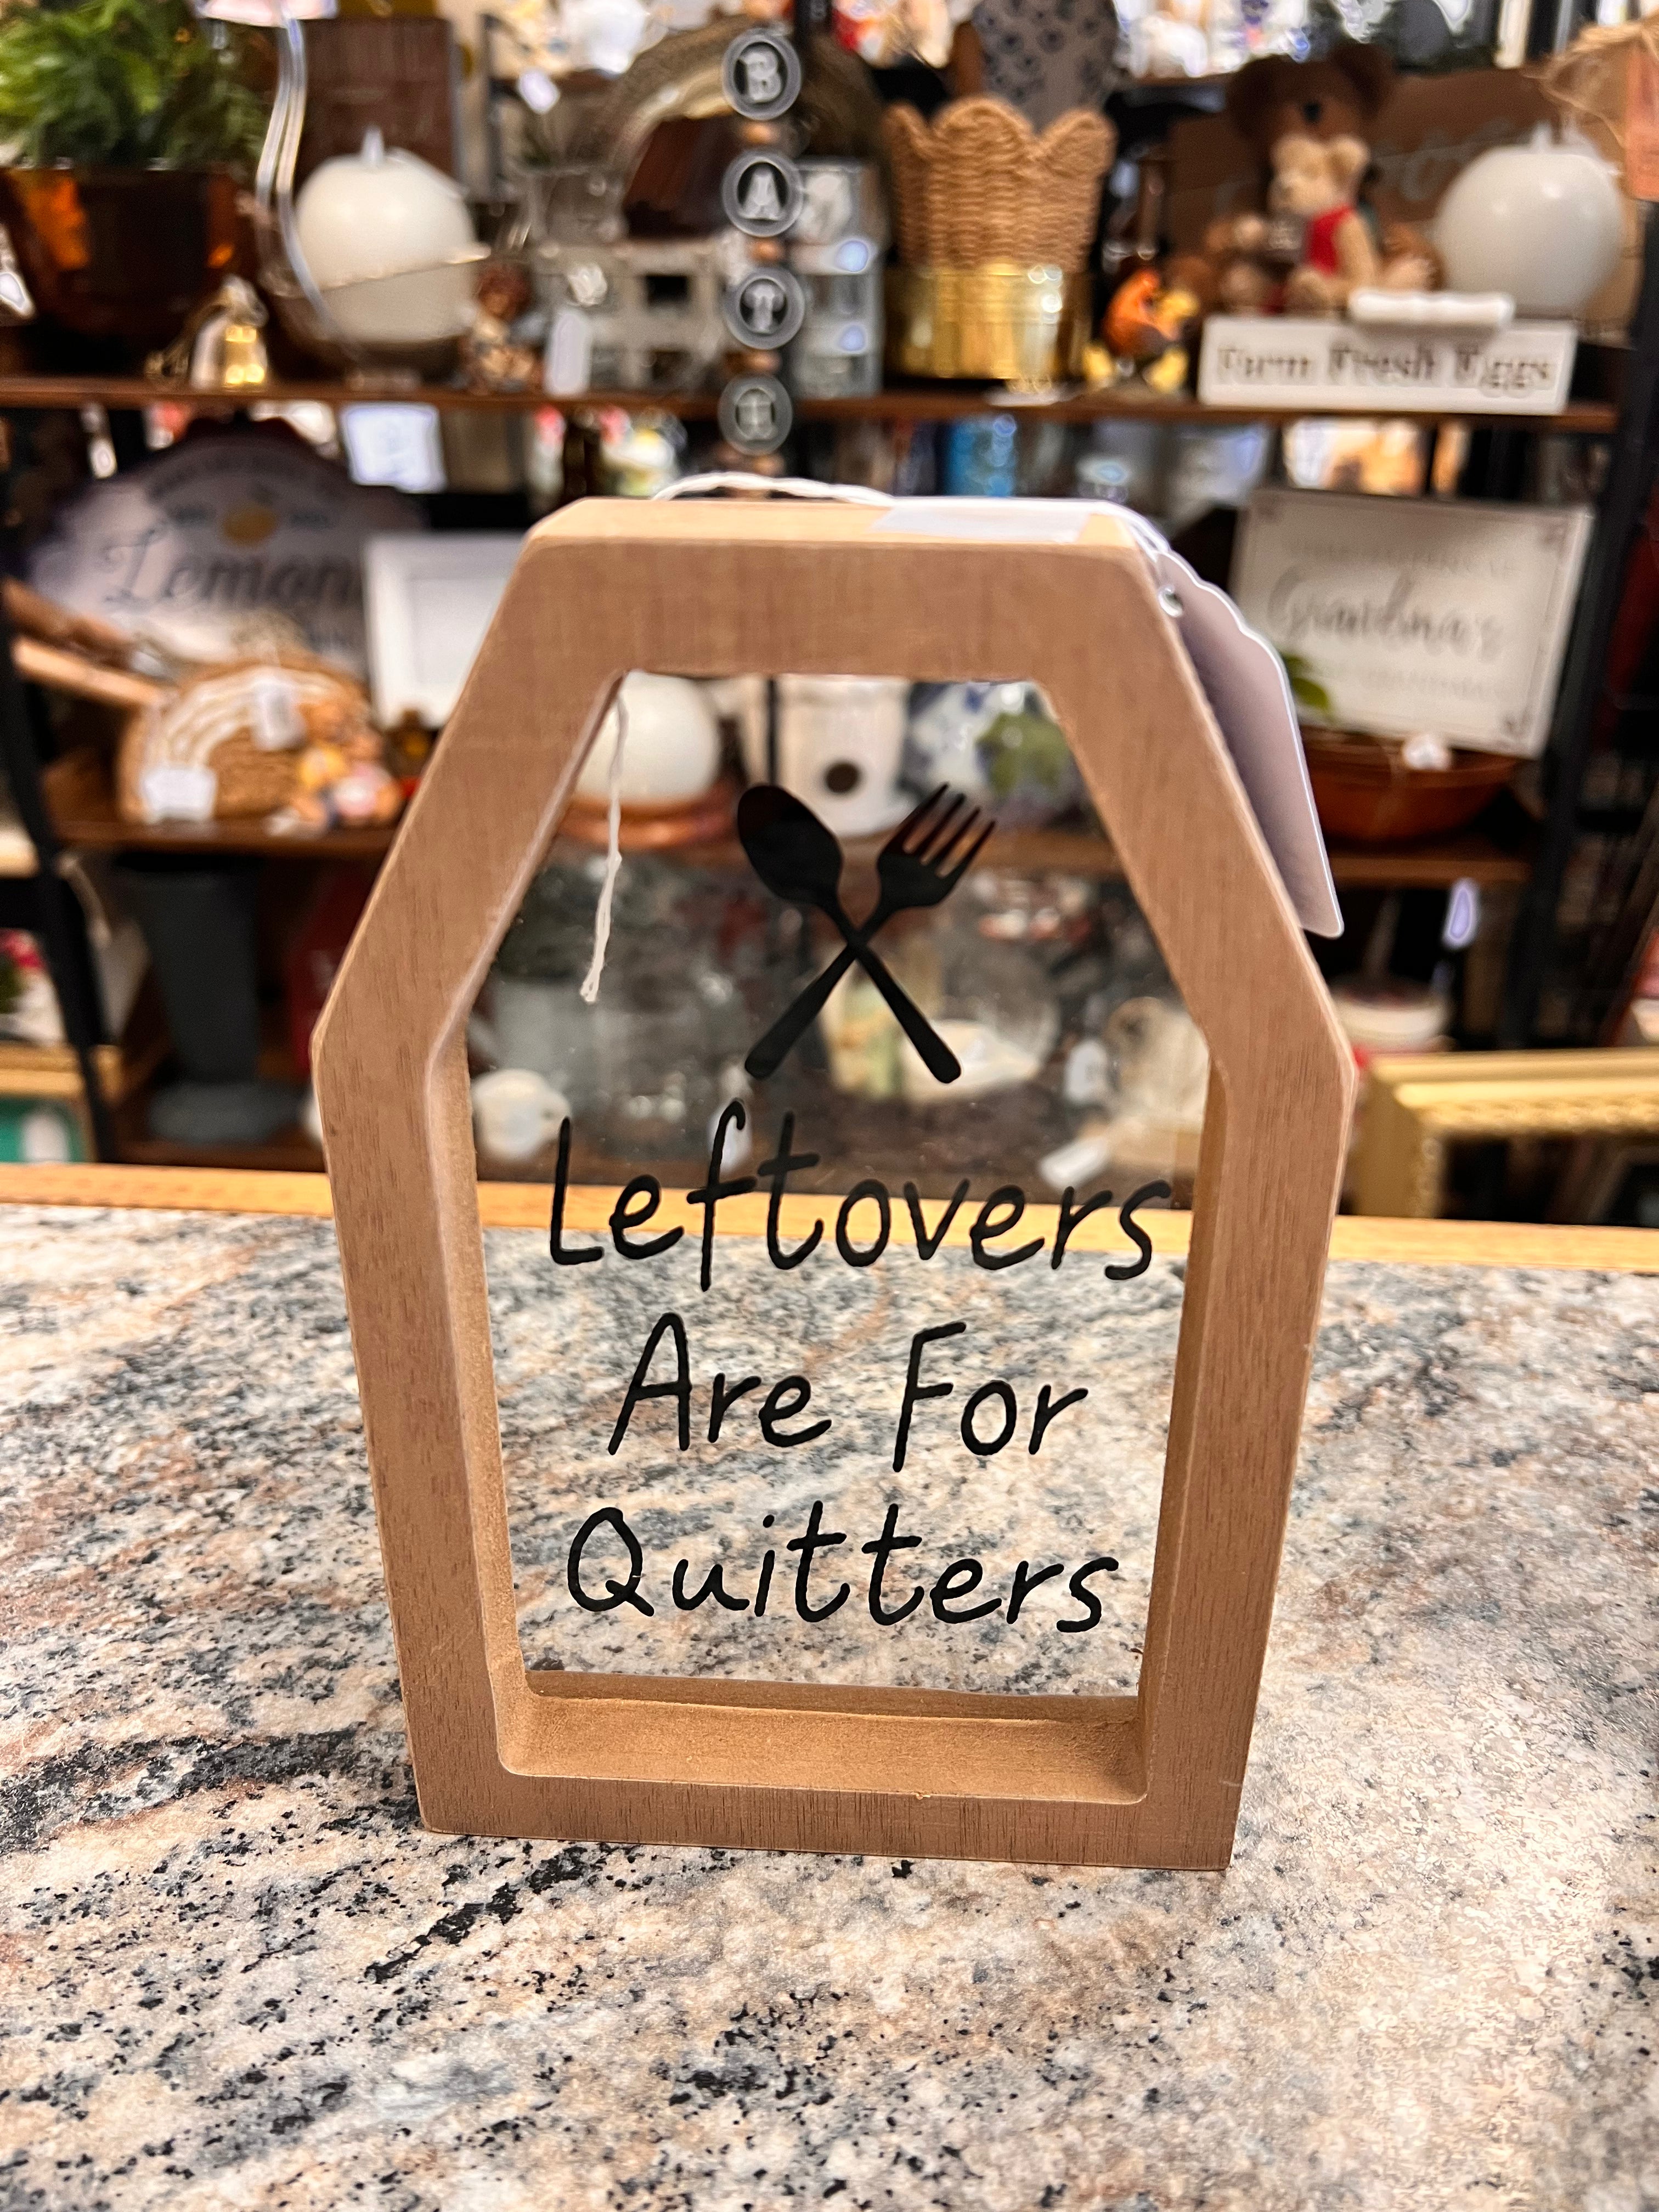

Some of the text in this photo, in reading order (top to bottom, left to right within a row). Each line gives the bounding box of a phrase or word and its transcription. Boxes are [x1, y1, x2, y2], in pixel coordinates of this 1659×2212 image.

[1216, 343, 1554, 393] Farm Fresh Eggs
[549, 1101, 1172, 1291] Leftovers
[607, 1313, 1089, 1472] Are For
[567, 1500, 1120, 1633] Quitters
